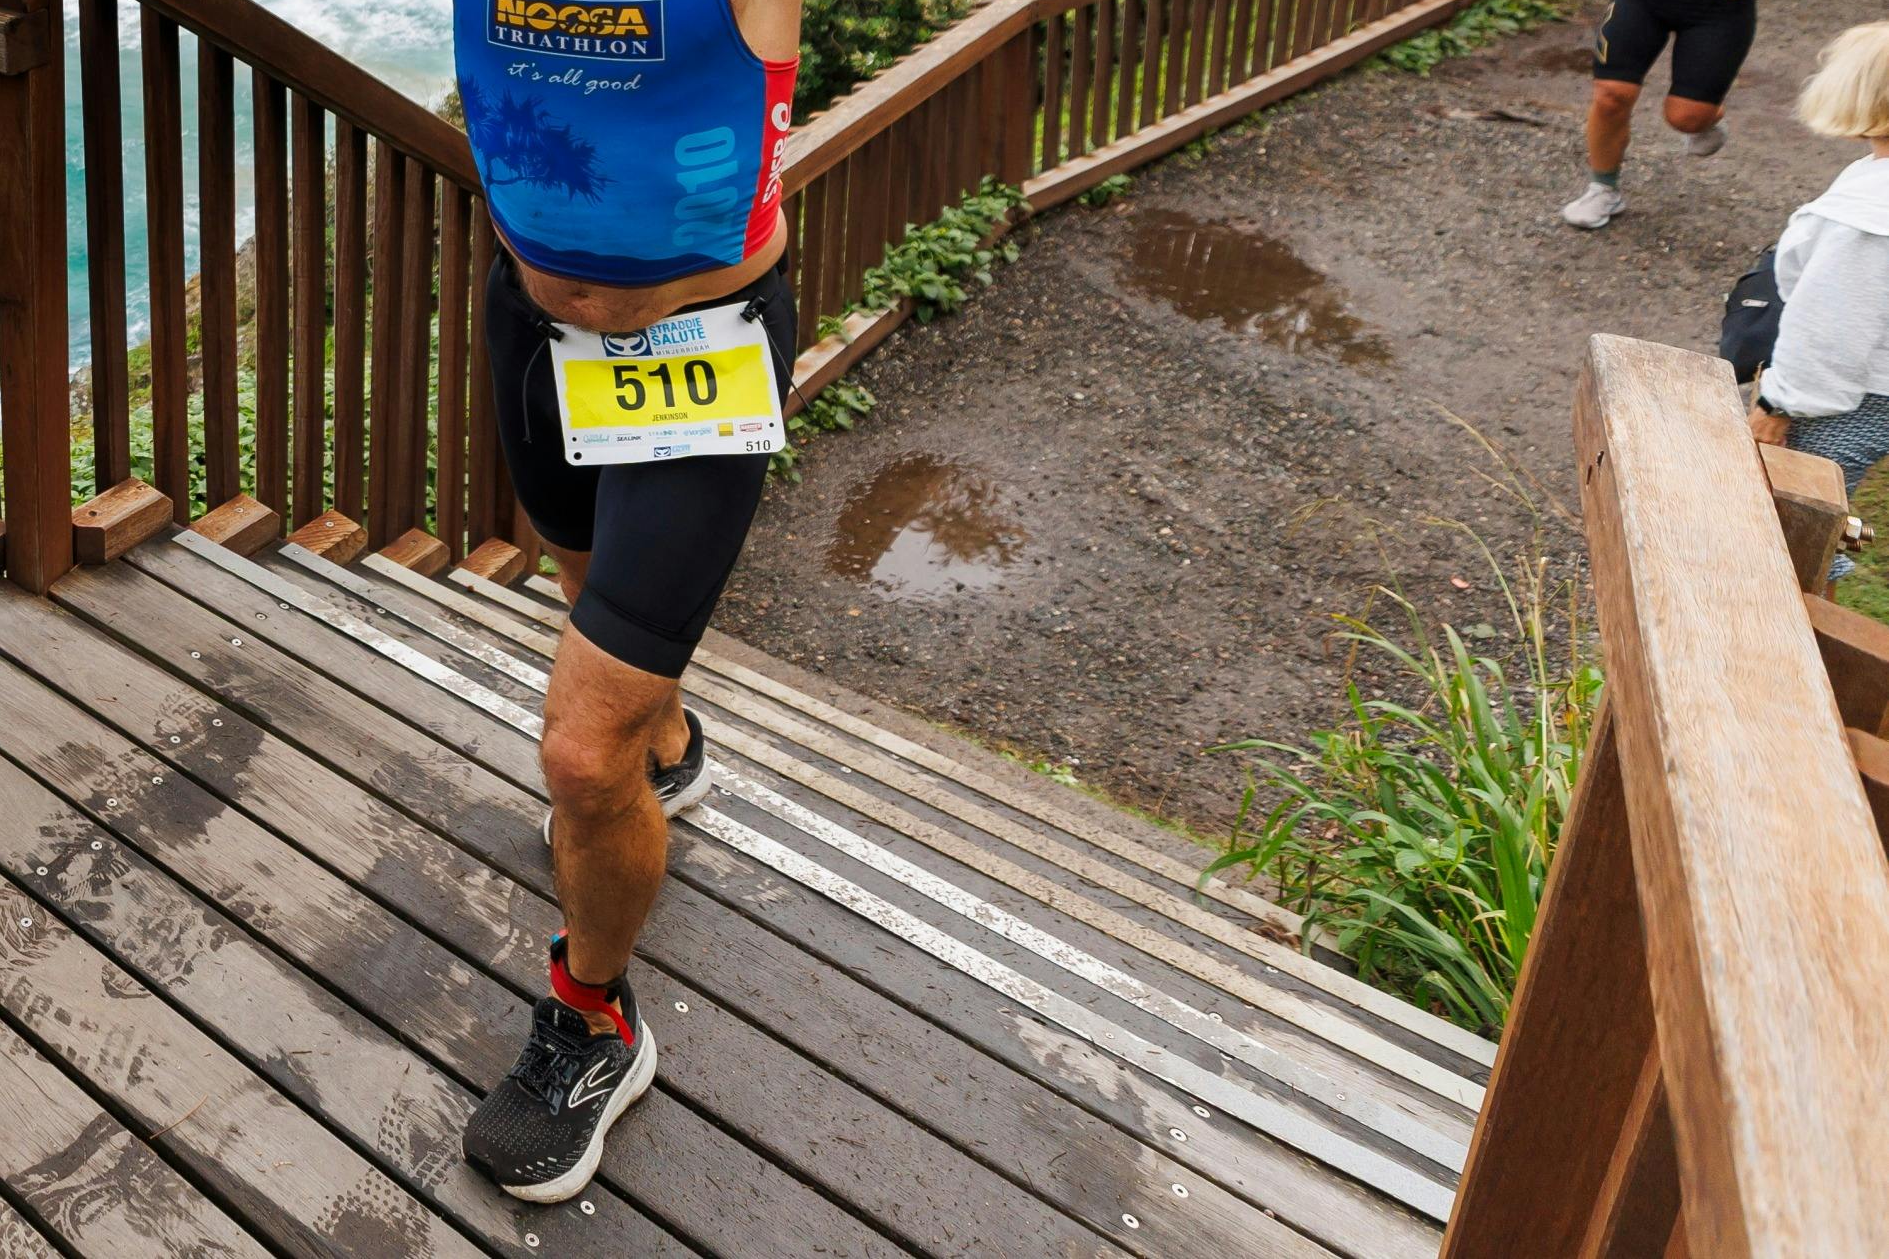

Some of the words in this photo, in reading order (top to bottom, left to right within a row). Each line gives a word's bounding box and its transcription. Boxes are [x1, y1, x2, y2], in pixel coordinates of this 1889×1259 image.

[495, 25, 648, 55] TRIATHLON
[507, 62, 543, 81] it's
[548, 68, 583, 86] all
[584, 73, 642, 95] good
[673, 126, 739, 247] 2010
[649, 317, 703, 335] STRADDIE
[651, 327, 706, 346] SALUTE
[613, 360, 718, 411] 510
[652, 412, 688, 422] JENKINSON
[746, 439, 771, 452] 510
